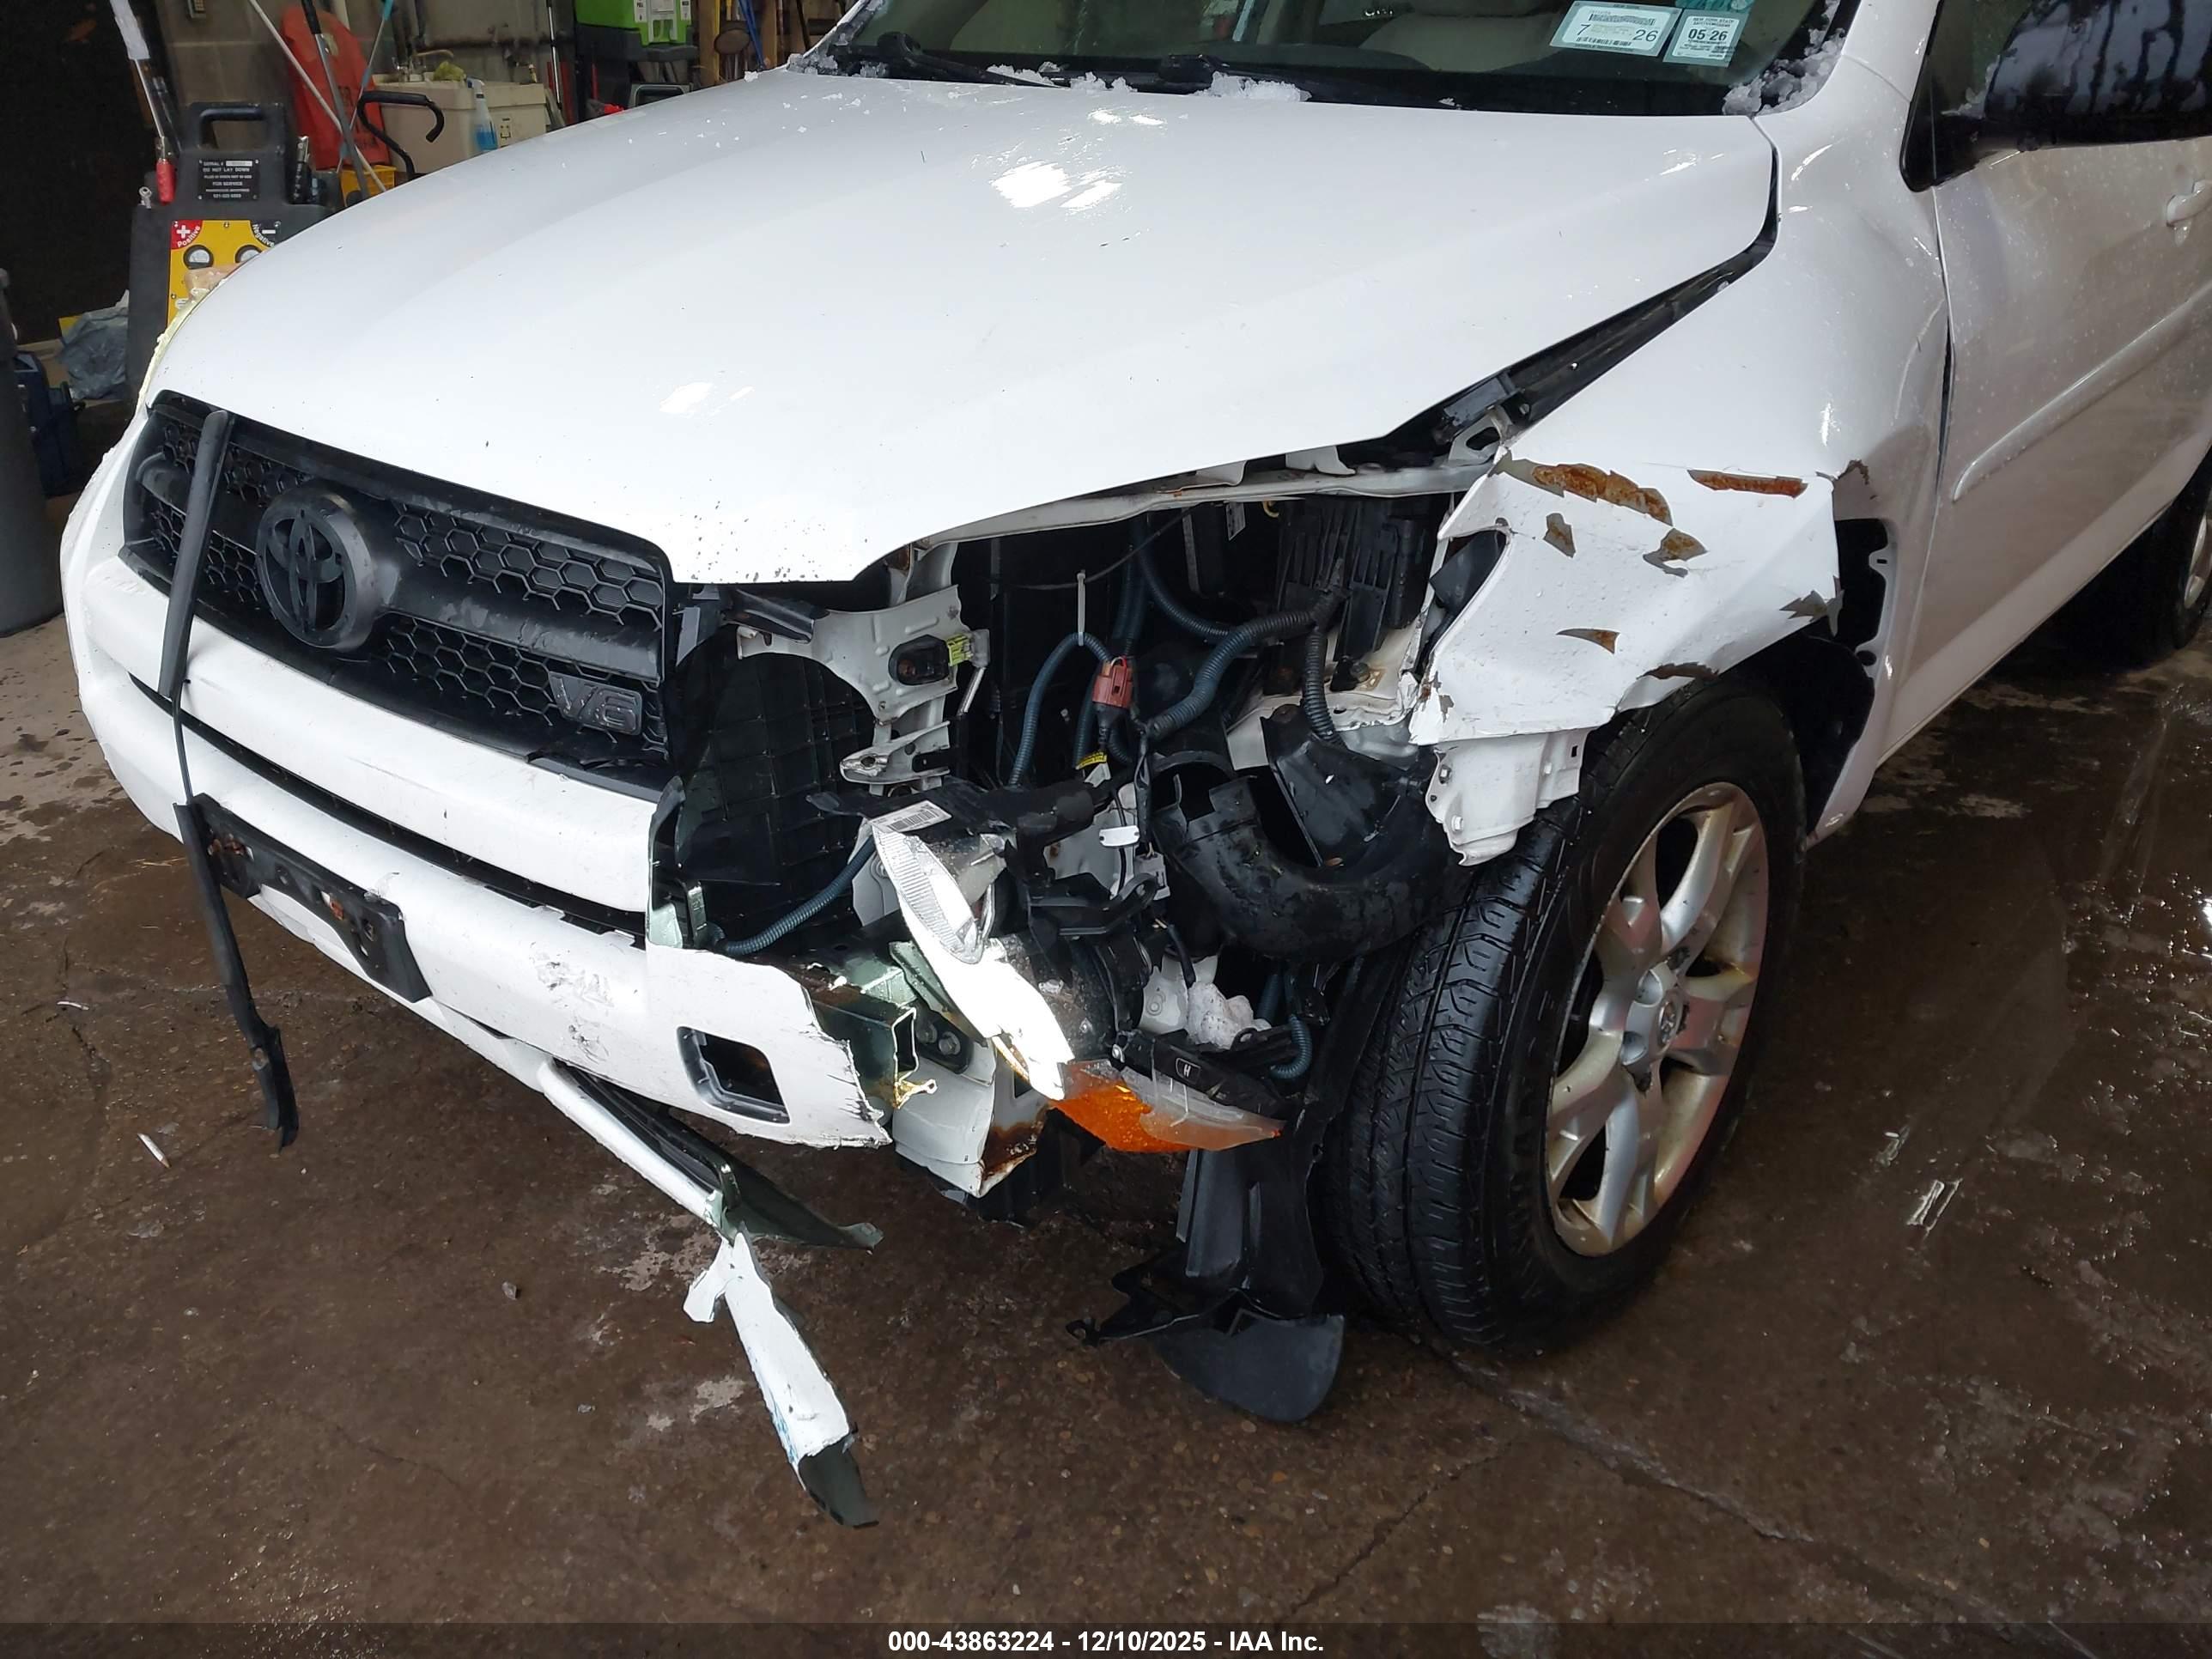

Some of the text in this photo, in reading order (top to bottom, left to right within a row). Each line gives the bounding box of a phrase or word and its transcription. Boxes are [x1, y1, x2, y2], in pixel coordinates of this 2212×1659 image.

[1577, 23, 1658, 42] 7 26
[1688, 28, 1729, 41] 05 26
[177, 223, 276, 248] Positive Negative
[551, 677, 636, 732] V6
[1183, 1064, 1192, 1078] H
